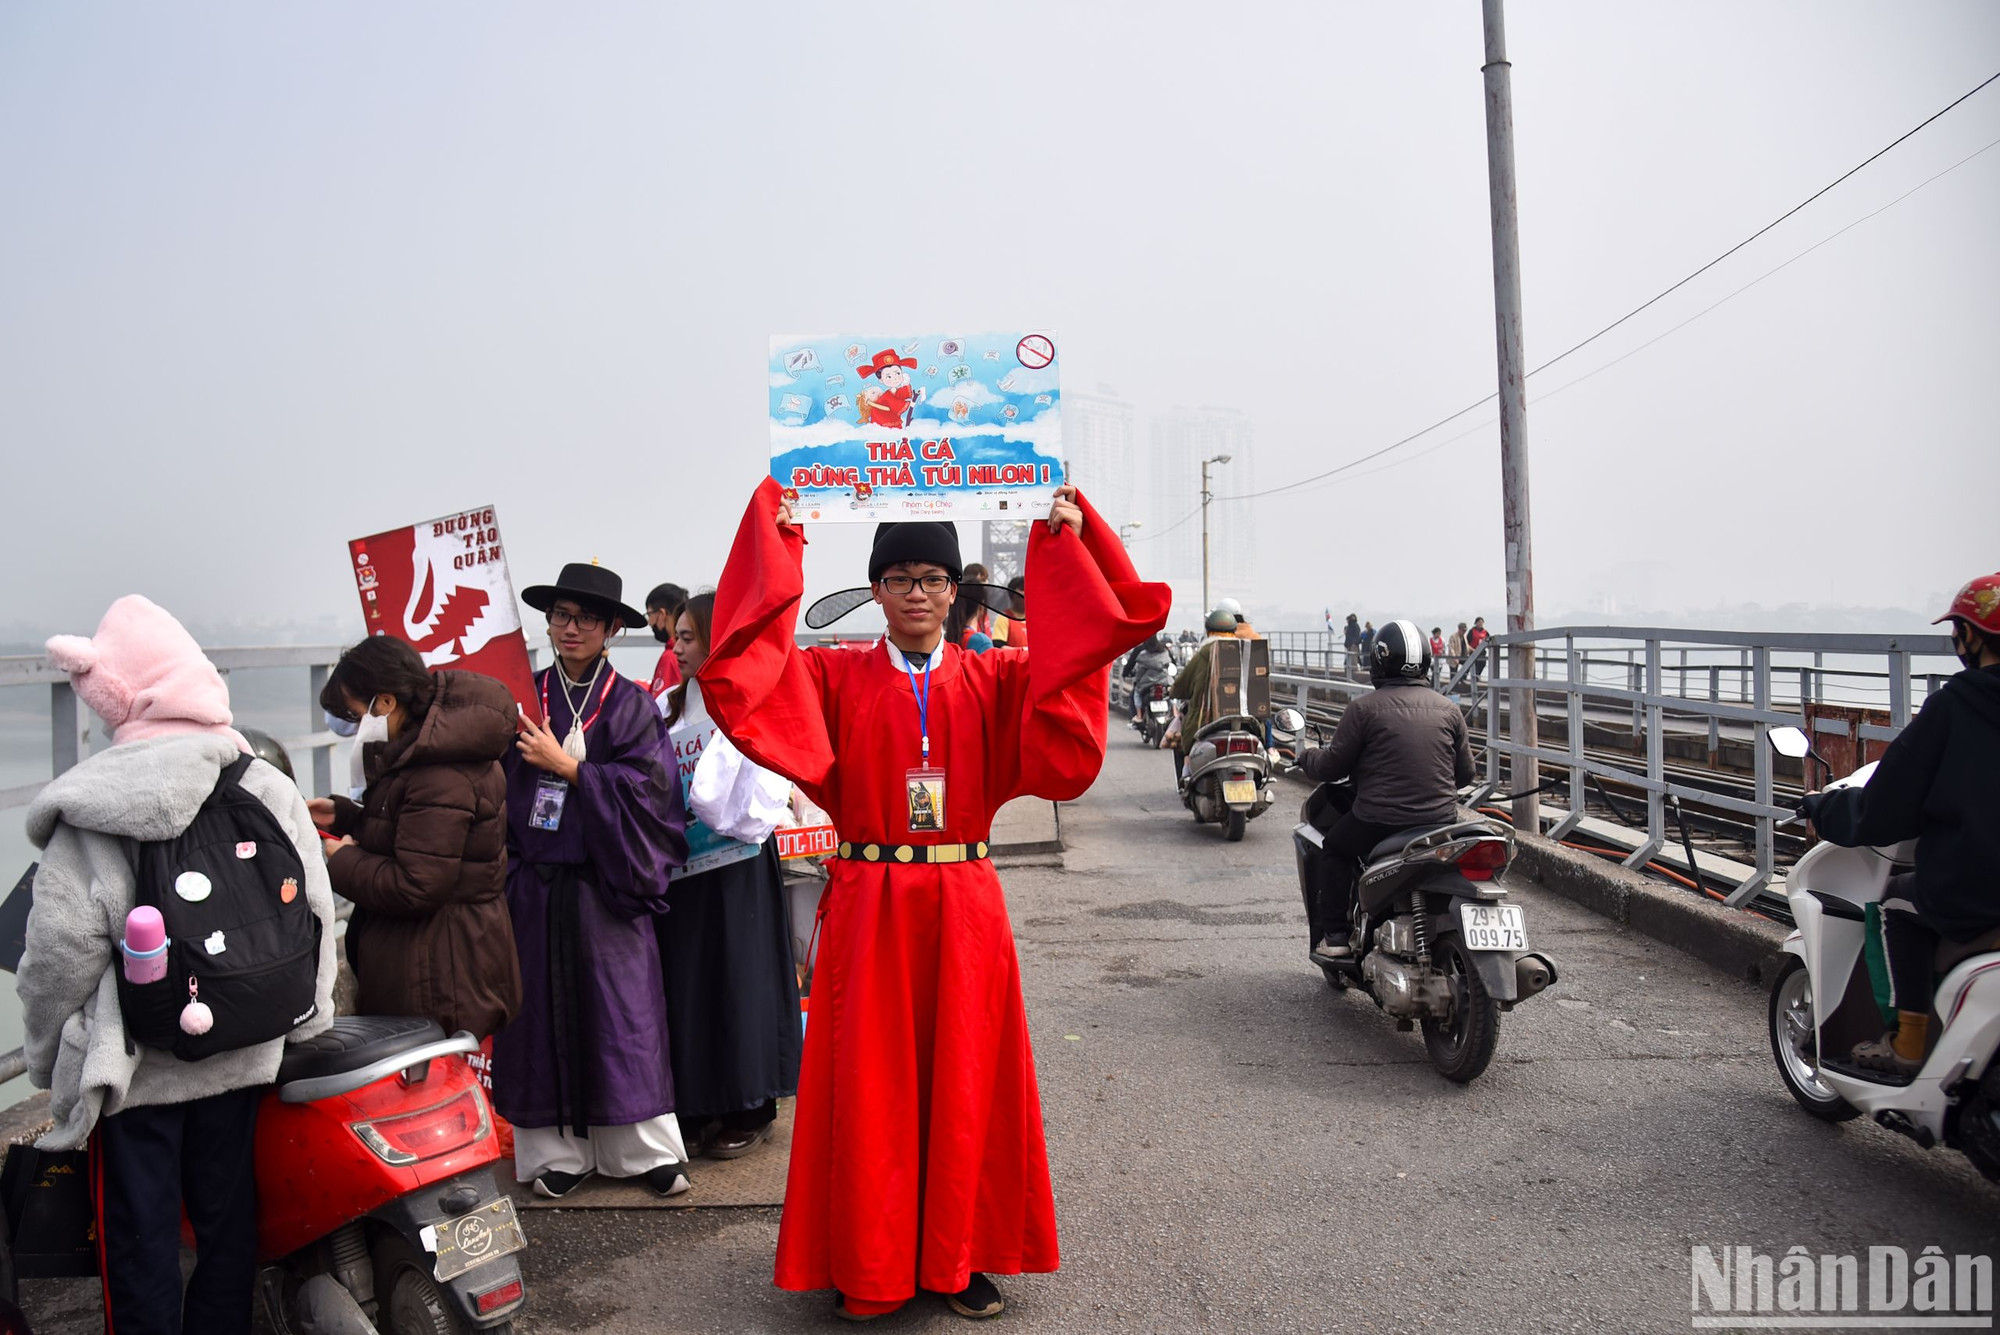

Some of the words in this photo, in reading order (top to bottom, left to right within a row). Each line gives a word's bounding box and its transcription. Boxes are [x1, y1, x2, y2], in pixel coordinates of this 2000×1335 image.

[866, 437, 914, 461] THẢ
[922, 437, 954, 460] CÁ
[792, 464, 858, 487] ĐỪNG
[867, 462, 915, 486] THẢ
[923, 462, 961, 486] TÚI
[968, 465, 1035, 485] NILON
[1042, 465, 1050, 483] !
[453, 545, 501, 571] QUÂN
[1471, 907, 1516, 928] 29-K1
[1469, 929, 1524, 949] 099.75
